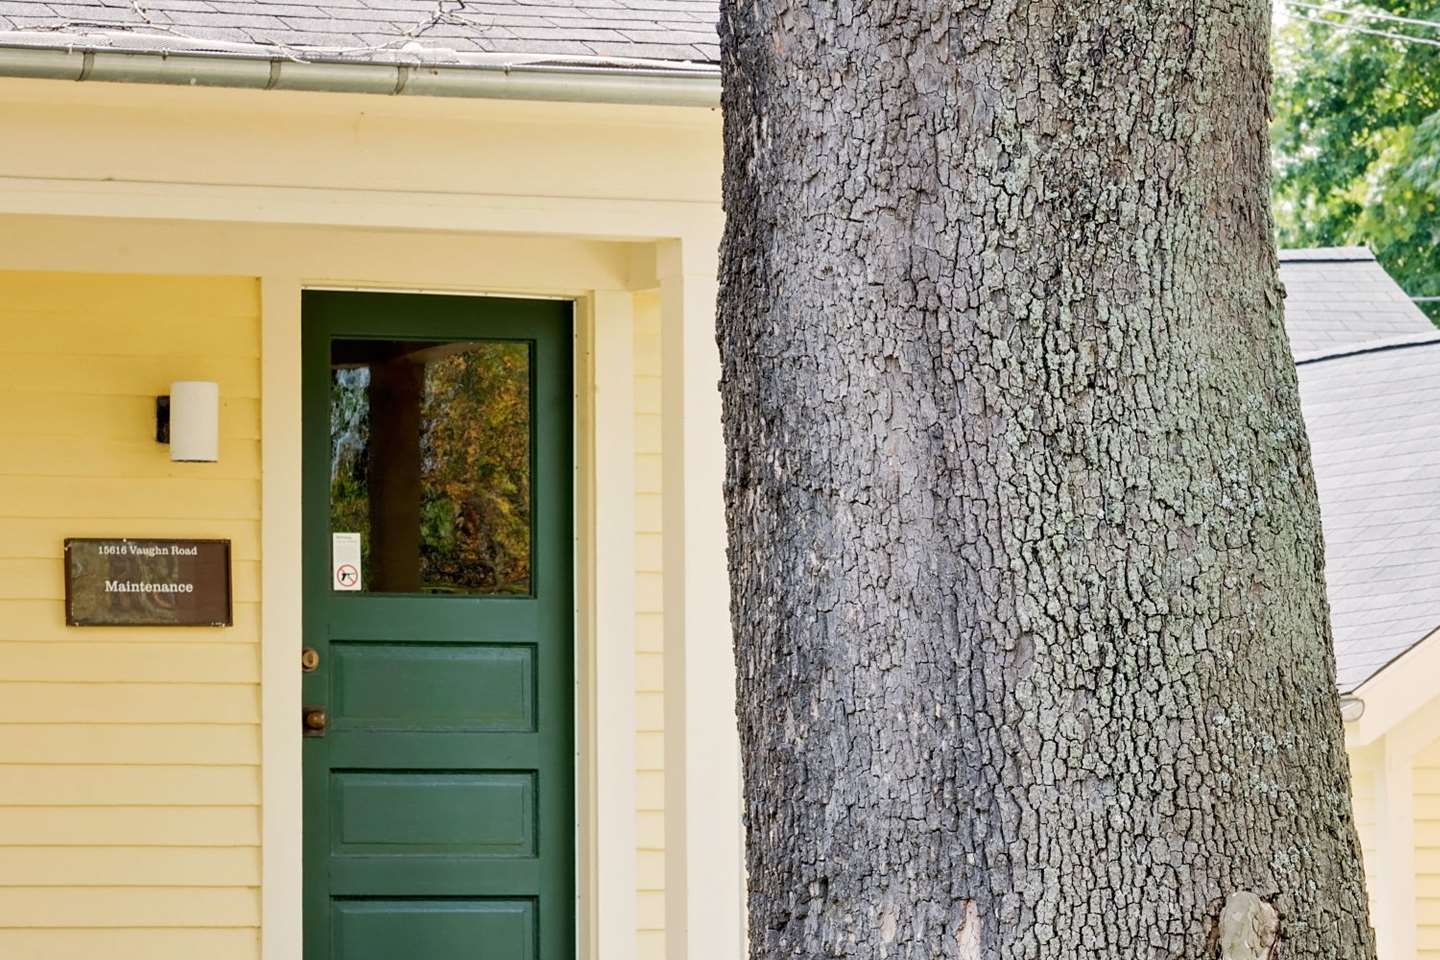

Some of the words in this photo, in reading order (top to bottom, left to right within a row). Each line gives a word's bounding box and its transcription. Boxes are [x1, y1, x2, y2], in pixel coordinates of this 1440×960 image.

[129, 545, 169, 557] Vaughn
[171, 546, 198, 556] Road
[104, 580, 194, 593] Maintenance
